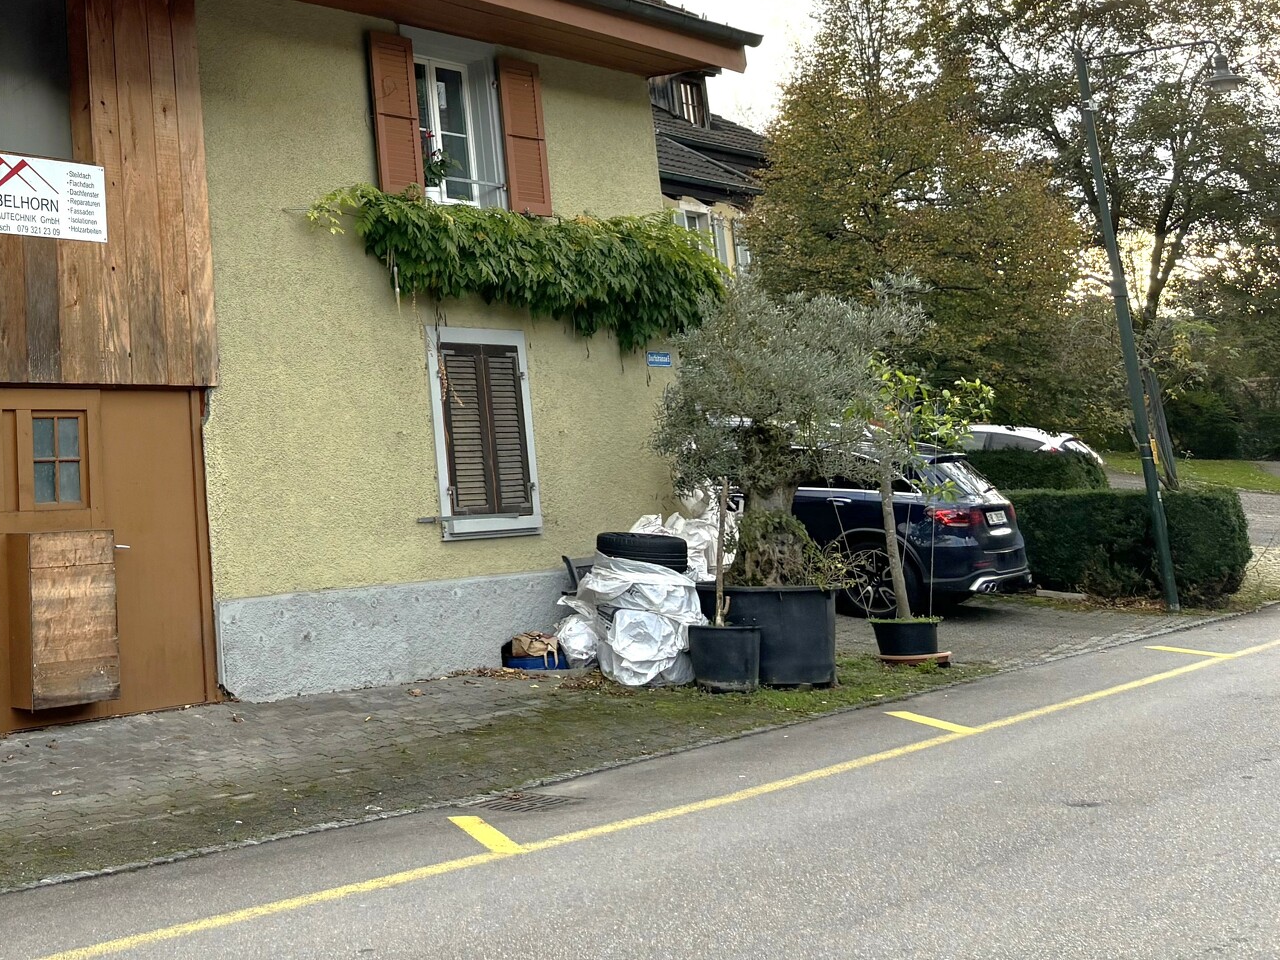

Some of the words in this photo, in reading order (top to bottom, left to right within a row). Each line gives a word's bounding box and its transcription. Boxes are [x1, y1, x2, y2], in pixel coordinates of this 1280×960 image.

[69, 170, 91, 180] Steildach
[69, 179, 94, 189] Flachdach
[70, 188, 99, 198] Dachfenster
[70, 197, 100, 207] Reparaturen
[70, 206, 94, 216] Fassaden
[40, 215, 60, 225] GmbH
[71, 216, 98, 226] Isolationen
[16, 224, 29, 233] 079
[30, 225, 41, 234] 321
[43, 226, 51, 236] 23
[52, 227, 61, 236] 09
[71, 225, 102, 235] Holzarbeiten
